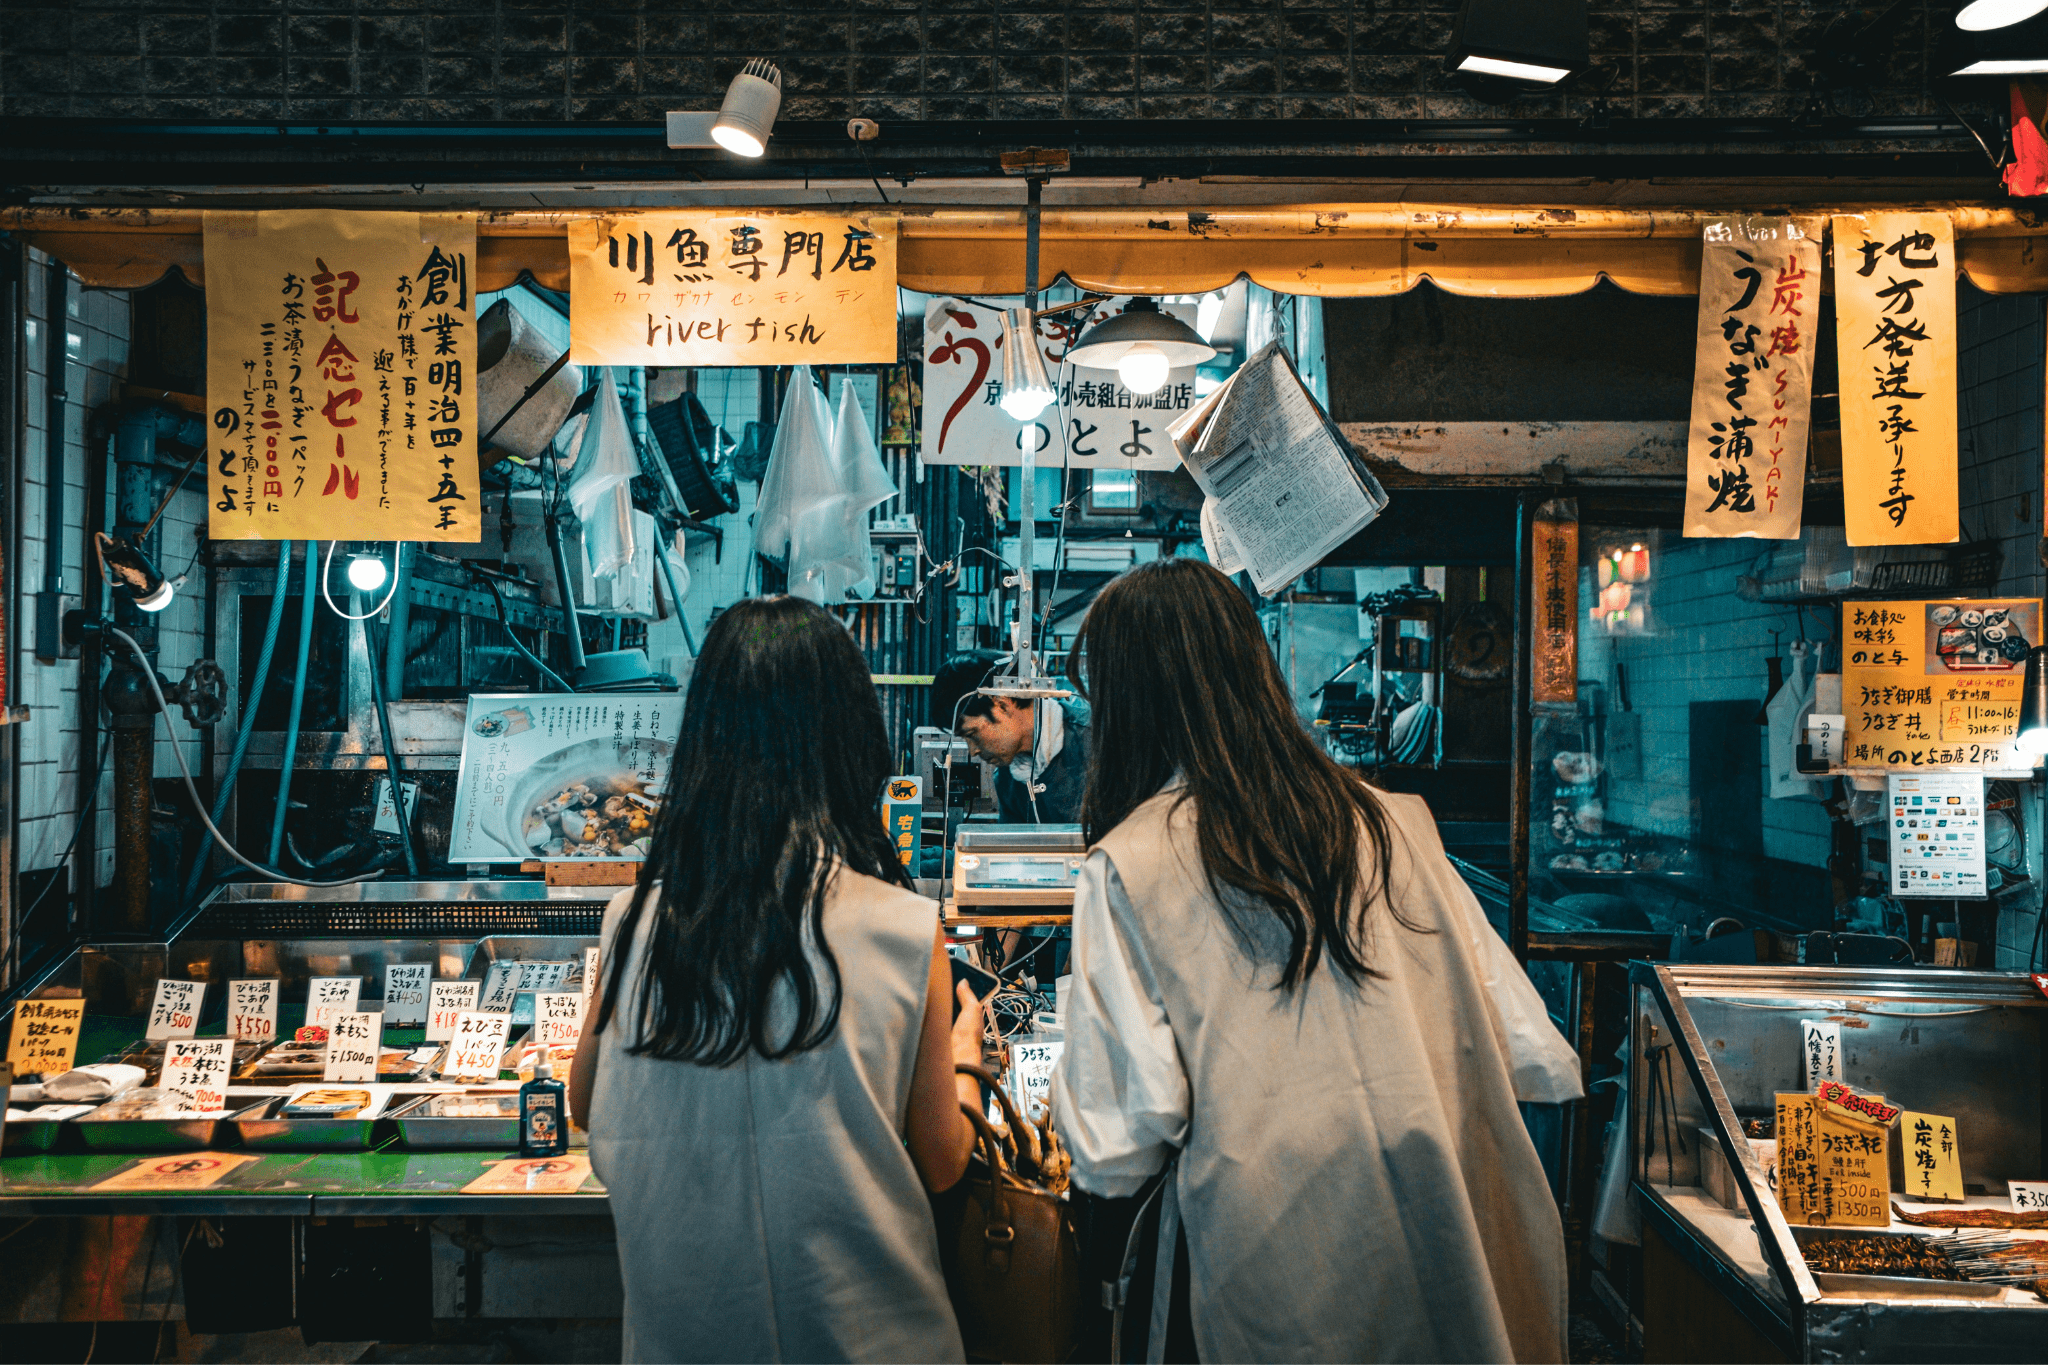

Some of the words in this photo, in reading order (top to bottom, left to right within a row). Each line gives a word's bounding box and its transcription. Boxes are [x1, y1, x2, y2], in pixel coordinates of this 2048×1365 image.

[608, 224, 877, 285] 川魚専門店
[647, 313, 732, 347] river
[745, 313, 826, 344] fish
[396, 274, 420, 450] おかげ様で百十年を
[310, 256, 363, 501] 記念セール
[416, 245, 468, 530] 創業明治四十五年
[1704, 249, 1770, 514] うなぎ蒲焼
[1856, 229, 1939, 528] 地方発送承ります
[983, 379, 1193, 411] 京小売組合加盟店
[241, 359, 260, 517] サービスさせて頂きます
[373, 347, 395, 510] 迎える事ができました
[1015, 418, 1153, 458] のとよ
[213, 406, 240, 513] のとよ
[1853, 607, 1906, 626] お食事処
[1851, 649, 1909, 666] のと与
[1860, 685, 1933, 707] うなぎ御膳
[1946, 688, 1991, 701] 営業時間
[1861, 711, 1922, 732] うなぎ丼
[1853, 744, 1885, 761] 場所
[1887, 747, 1965, 766] のとよ西店
[390, 966, 425, 979] びわ湖産
[543, 995, 578, 1009] すっぽん
[165, 1010, 193, 1029] ¥500
[235, 1014, 271, 1036] ¥550
[334, 1022, 369, 1039] 本もろこ
[435, 1010, 458, 1029] ¥18
[461, 1017, 504, 1037] えび豆
[175, 1043, 223, 1056] びわ湖
[465, 1038, 498, 1053] 1パック
[1020, 1046, 1052, 1063] うなぎの
[456, 1050, 495, 1069] ¥450
[1821, 1132, 1883, 1156] うなぎのキモ
[1914, 1118, 1937, 1190] 炭焼です
[1940, 1123, 1953, 1164] 全部
[1847, 1168, 1871, 1179] inside
[1838, 1179, 1880, 1198] 500円
[2014, 1187, 2030, 1208] 一本
